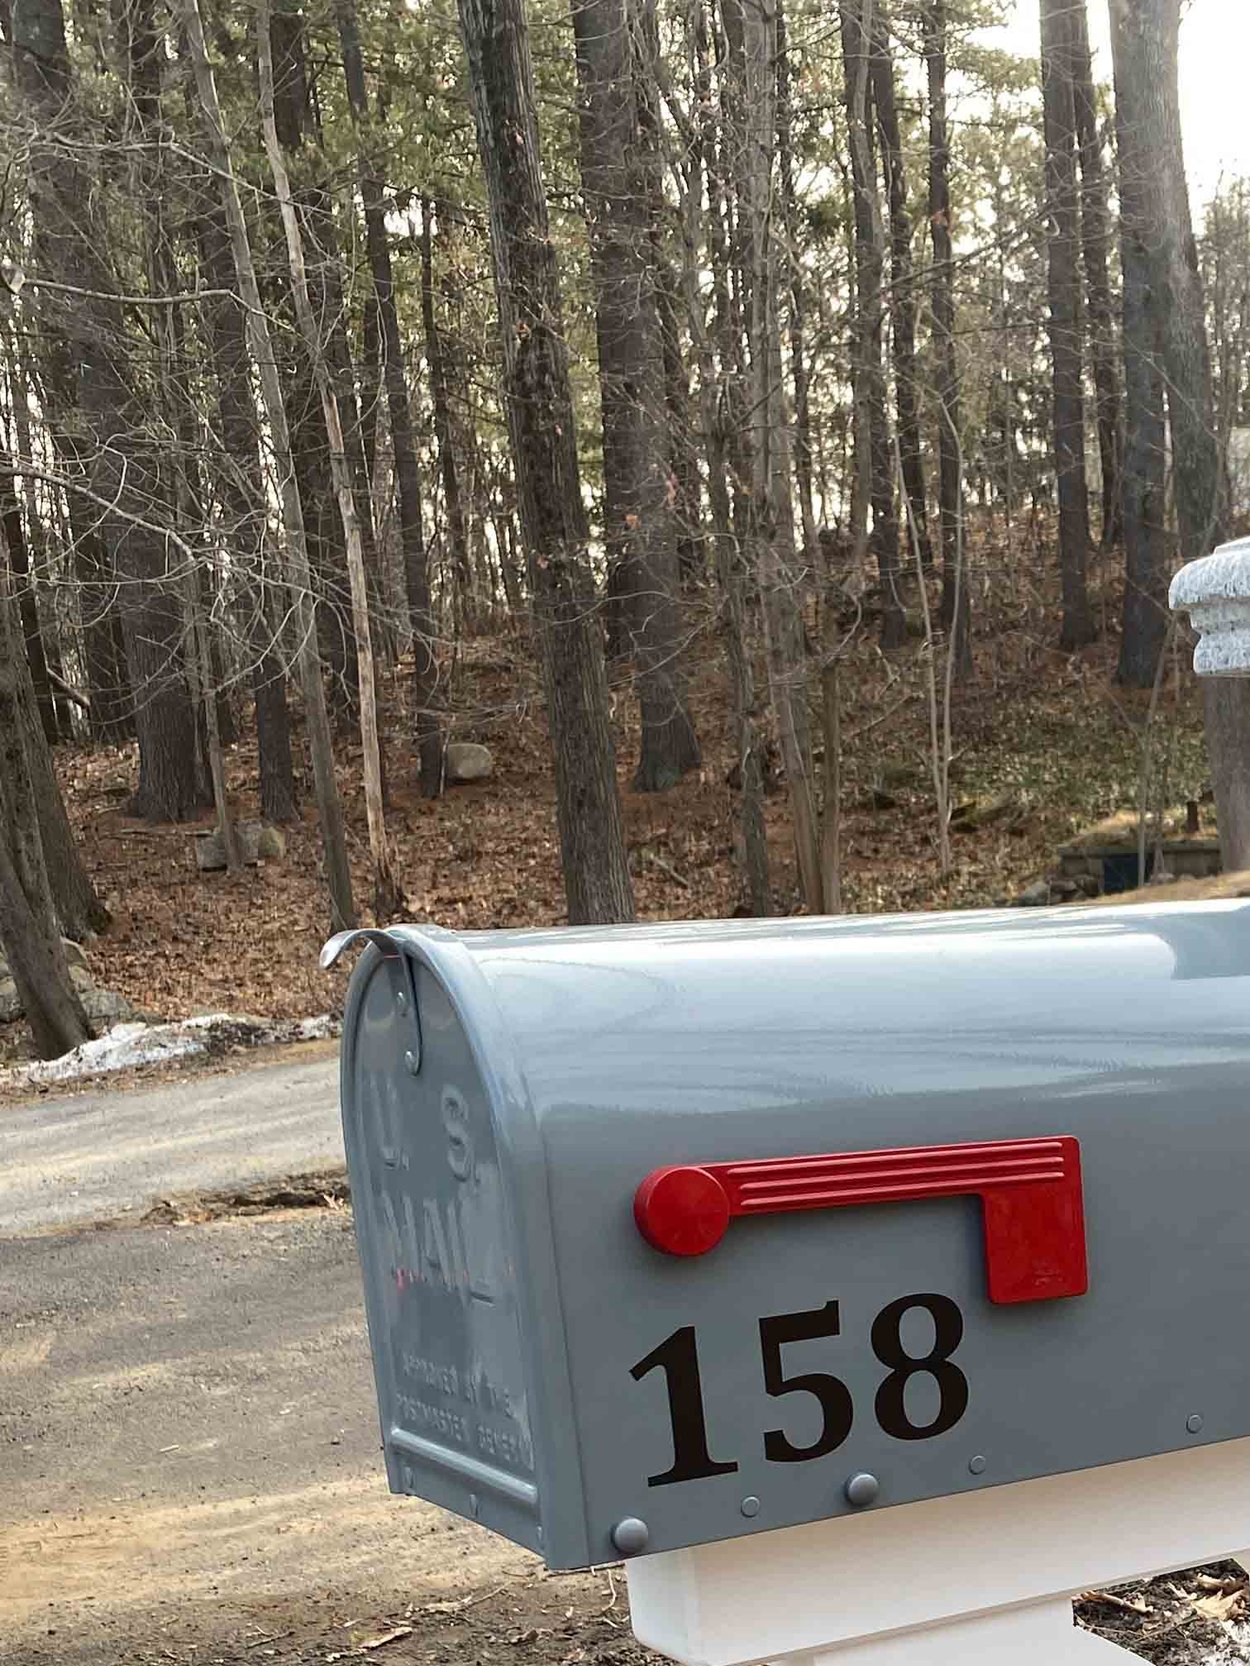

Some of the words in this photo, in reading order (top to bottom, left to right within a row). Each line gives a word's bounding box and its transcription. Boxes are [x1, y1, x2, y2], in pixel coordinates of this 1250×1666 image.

[380, 1190, 498, 1308] MAIL
[487, 1381, 516, 1420] TE
[629, 1293, 968, 1487] 158
